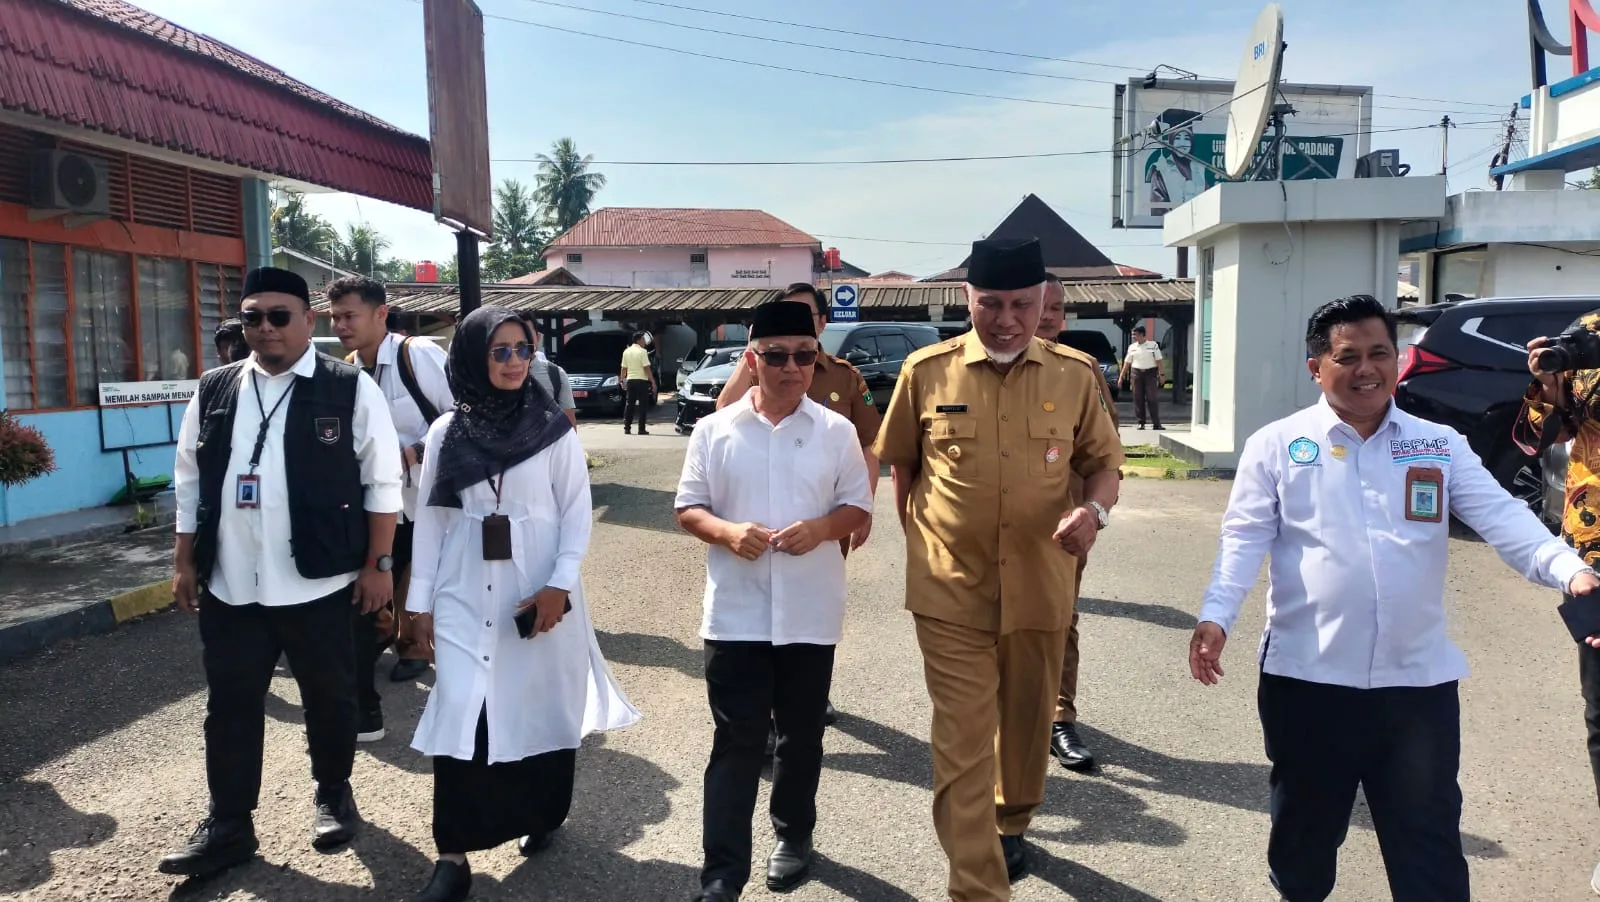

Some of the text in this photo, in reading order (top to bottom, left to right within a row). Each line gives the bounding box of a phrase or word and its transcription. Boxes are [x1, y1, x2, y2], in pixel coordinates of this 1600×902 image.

[1254, 41, 1265, 60] BRI
[1299, 142, 1335, 156] PADANG
[105, 393, 140, 404] MEMILAH
[141, 392, 170, 401] SAMPAH
[1391, 438, 1448, 451] BBPMP
